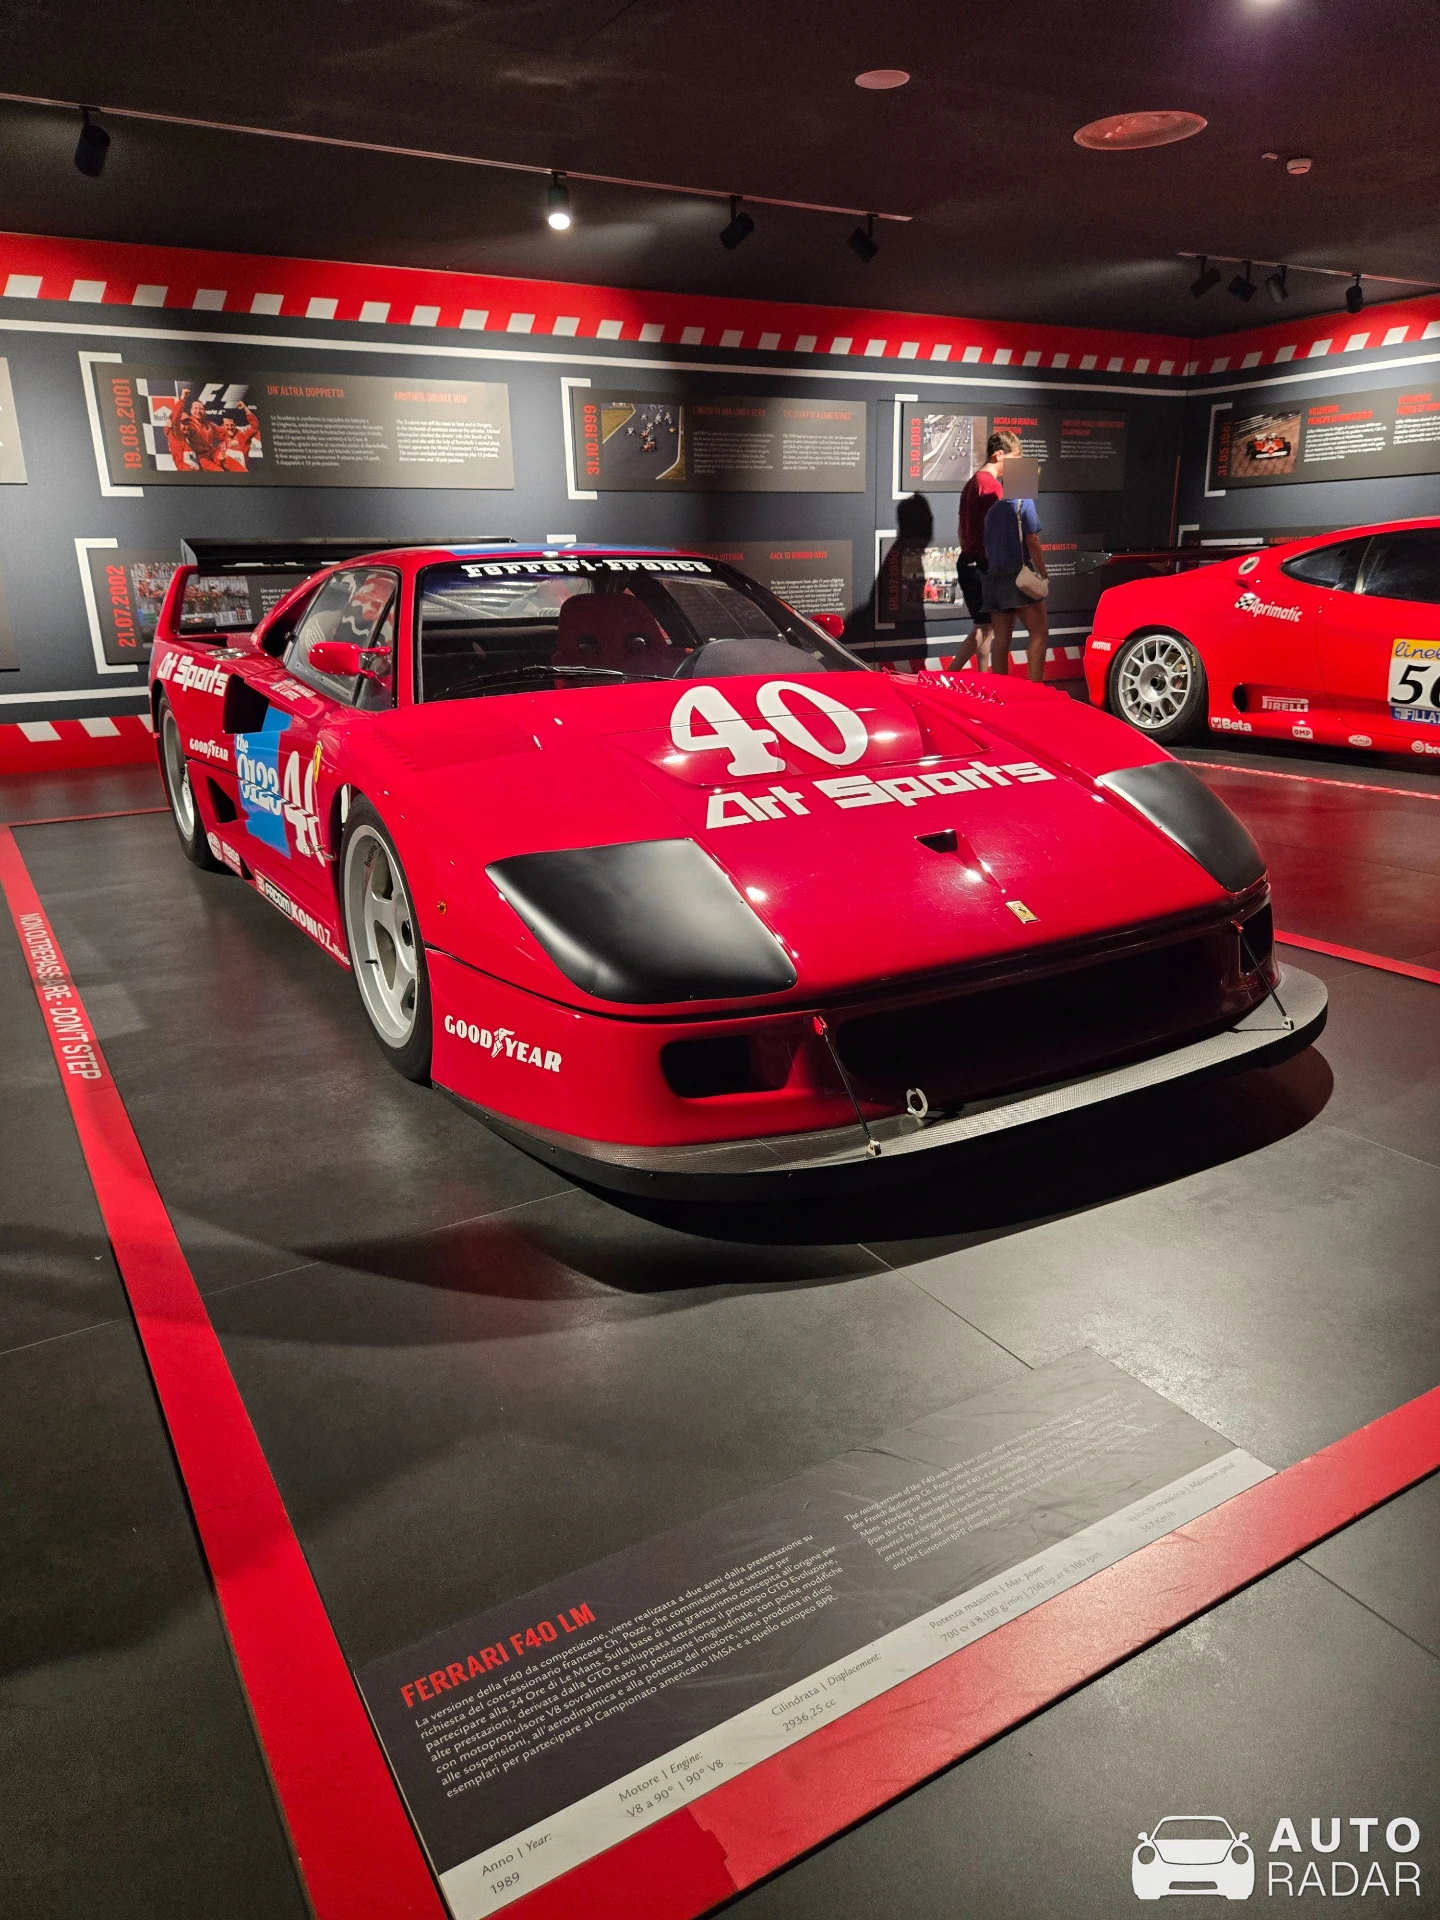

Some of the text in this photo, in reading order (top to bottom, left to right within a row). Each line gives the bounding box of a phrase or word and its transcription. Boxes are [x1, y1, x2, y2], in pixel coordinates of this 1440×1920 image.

[114, 378, 142, 469] 19.08.2001
[584, 404, 600, 476] 31.10.1999
[910, 417, 922, 478] 15.10.1983
[106, 565, 137, 648] 21.07.2002
[1248, 596, 1304, 622] Aprimatic
[173, 655, 229, 697] Sports
[1262, 696, 1309, 712] PIRELLI
[236, 734, 248, 753] the
[670, 680, 868, 776] 40
[1221, 718, 1252, 732] Beta
[706, 760, 1056, 829] Art Sports
[291, 901, 318, 938] KONI
[19, 912, 102, 1080] NON OLTREPASSARE DON'T STEP
[444, 1014, 562, 1074] GOODYEAR
[400, 1603, 595, 1707] FERRARI F40 LM
[414, 1717, 430, 1728] La
[430, 1695, 475, 1720] versione
[476, 1682, 502, 1698] della
[502, 1670, 523, 1685] F40
[525, 1665, 539, 1675] da
[540, 1633, 608, 1668] competizione,
[607, 1620, 633, 1634] viene
[633, 1599, 677, 1623] realizzata
[685, 1587, 703, 1598] due
[703, 1575, 723, 1590] anni
[723, 1566, 746, 1580] dalla
[746, 1539, 803, 1571] presentazione
[802, 1534, 814, 1542] su
[420, 1556, 789, 1739] richiesta del concessionario francese Ch. Pozzi, che commissiona due vetture per
[446, 1764, 500, 1798] esemplari
[502, 1755, 519, 1772] per
[522, 1724, 582, 1762] partecipare
[583, 1716, 594, 1728] al
[594, 1686, 657, 1721] Campionato
[658, 1660, 709, 1689] americano
[708, 1645, 737, 1663] IMSA
[751, 1624, 779, 1642] quello
[780, 1605, 816, 1627] europeo
[815, 1594, 839, 1608] BPR.
[771, 1653, 882, 1716] Cilindrata Displacement:
[781, 1698, 837, 1732] 2936,25 cc
[618, 1751, 703, 1802] Motore Engine:
[482, 1833, 552, 1876] Anno Year:
[489, 1871, 520, 1894] 1989
